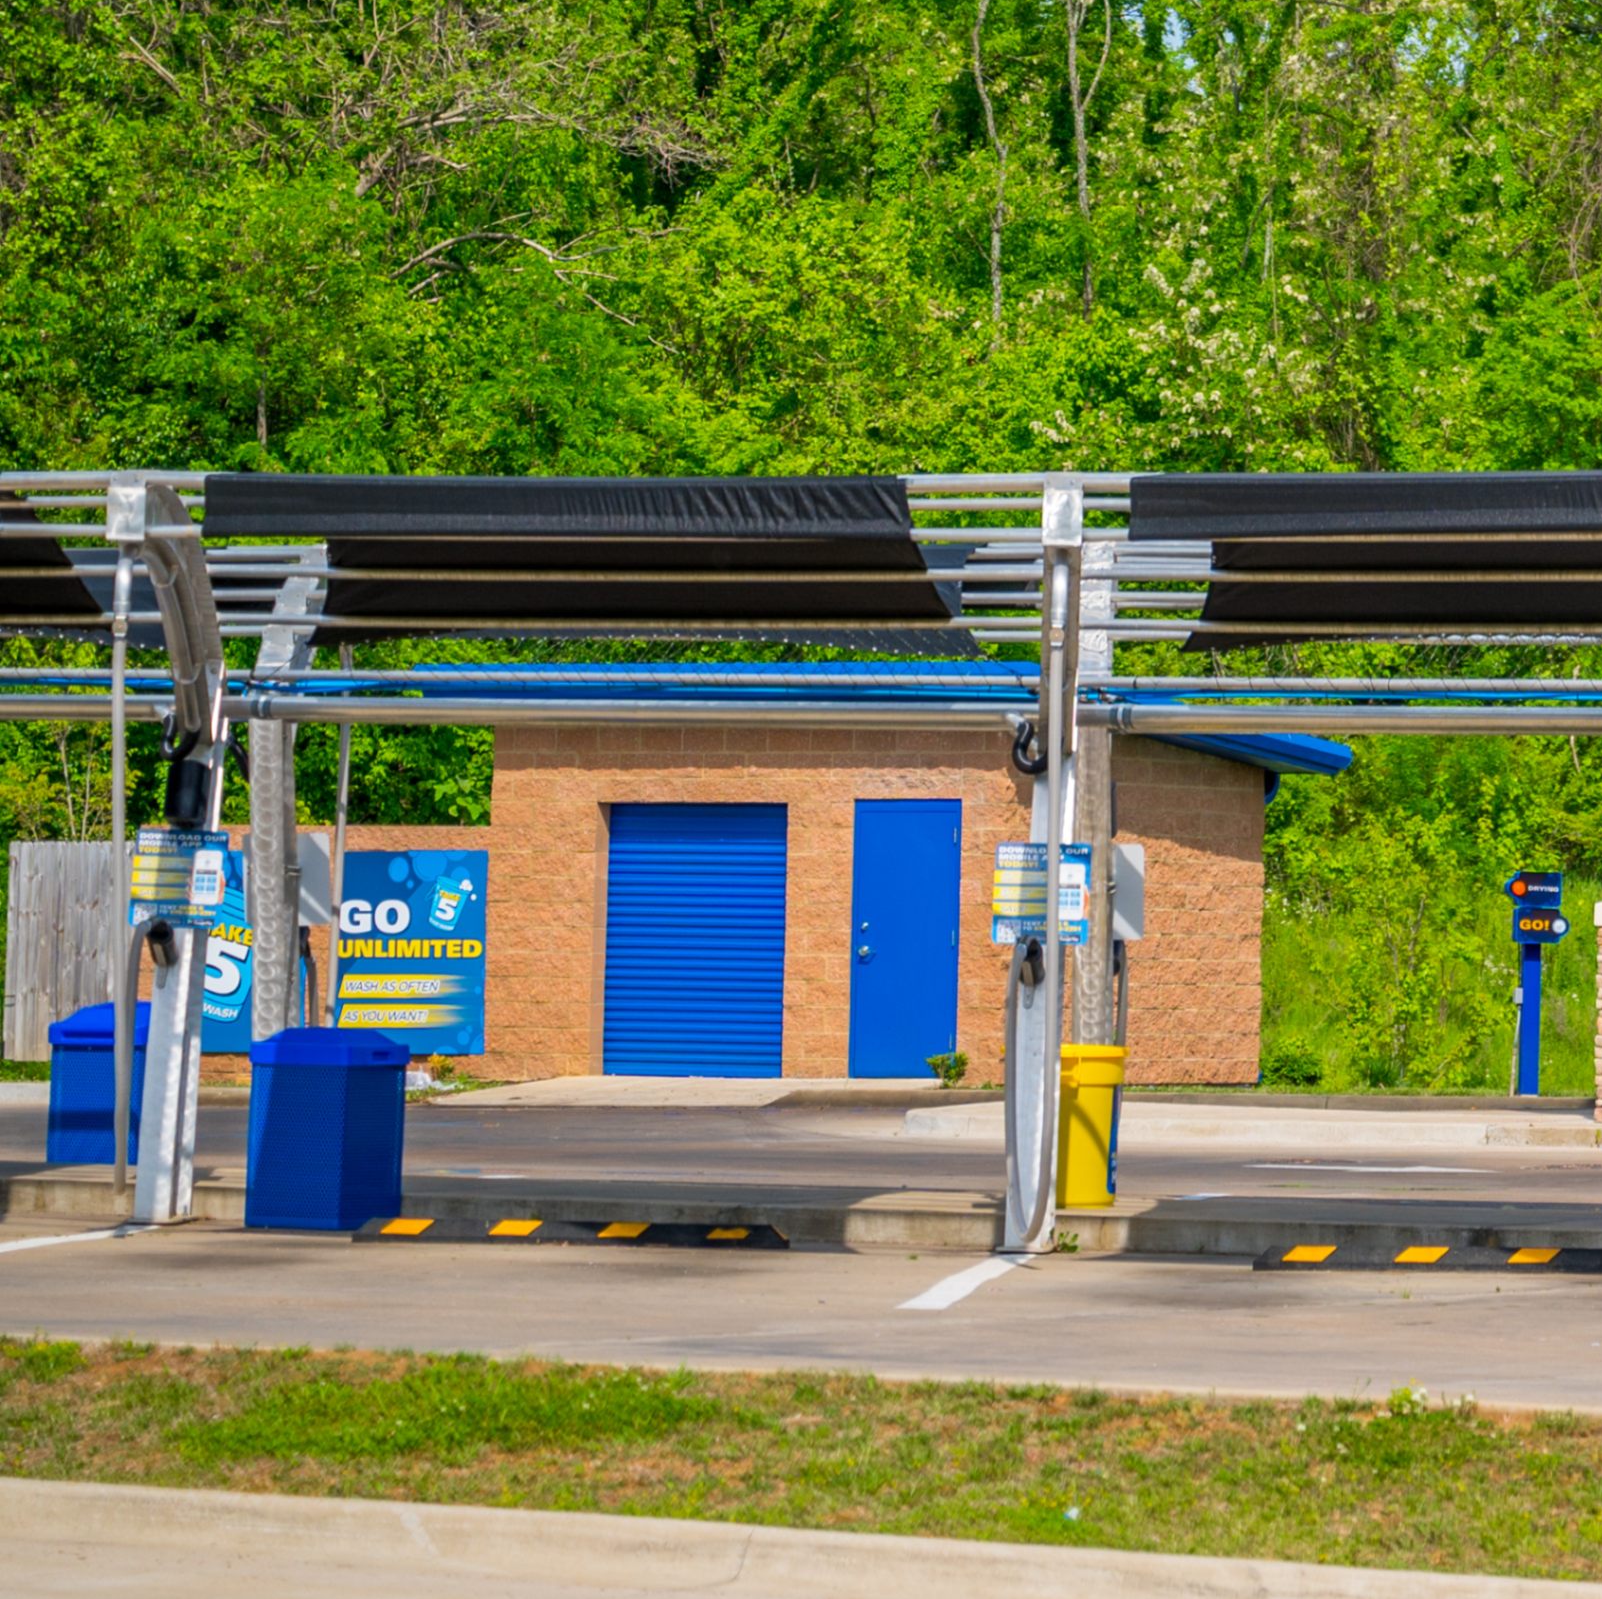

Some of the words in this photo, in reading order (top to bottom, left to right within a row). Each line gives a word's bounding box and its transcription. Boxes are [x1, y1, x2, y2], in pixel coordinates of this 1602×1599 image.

[998, 846, 1062, 854] DOWNLO
[1528, 885, 1560, 893] DRYING
[339, 899, 411, 934] GO
[435, 898, 458, 921] 5
[1519, 919, 1550, 931] GO!
[208, 923, 253, 946] AKE
[337, 939, 483, 959] UNLIMITED
[204, 935, 249, 996] 5
[345, 980, 379, 992] WASH
[381, 981, 396, 992] AS
[398, 981, 440, 992] OFTEN
[204, 1002, 240, 1019] WASH
[343, 1010, 359, 1022] AS
[362, 1011, 386, 1022] YOU
[388, 1011, 428, 1022] WANT!
